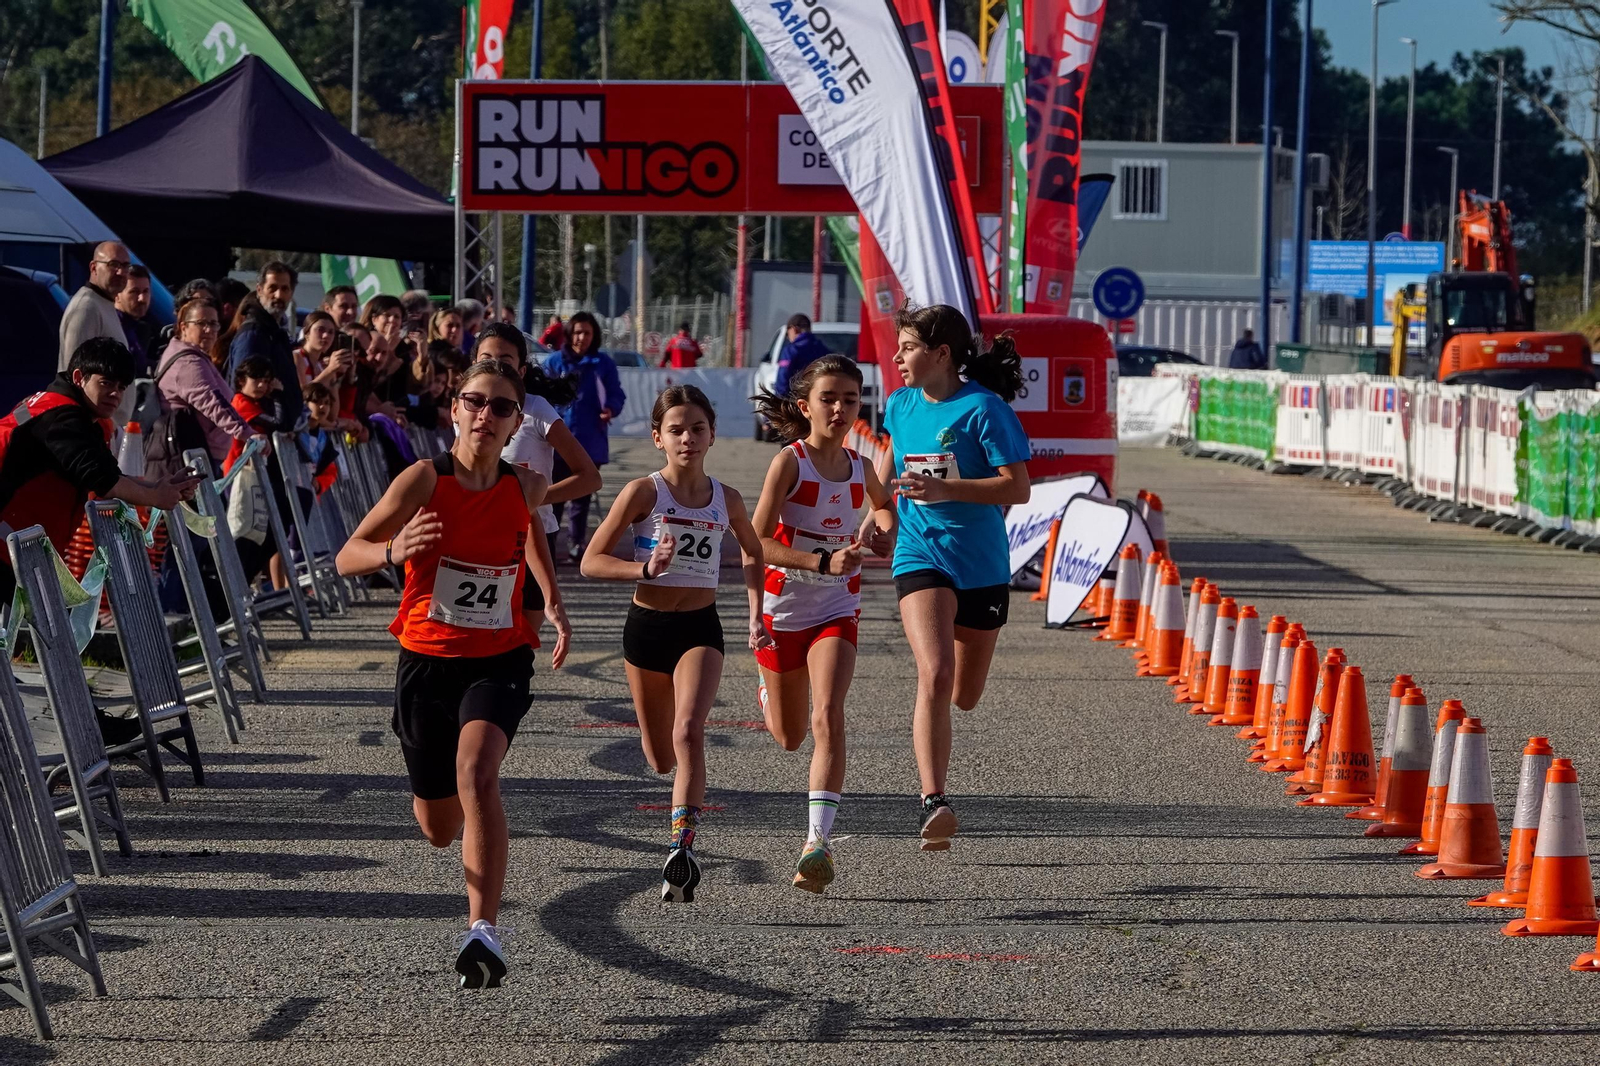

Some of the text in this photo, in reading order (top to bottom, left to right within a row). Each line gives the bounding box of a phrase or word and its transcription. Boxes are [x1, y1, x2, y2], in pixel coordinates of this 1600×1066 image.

[770, 0, 845, 104] Atlántico
[479, 99, 601, 144] RUN
[803, 152, 831, 168] DE
[1496, 352, 1550, 363] mateco
[677, 532, 713, 560] 26
[476, 568, 496, 576] VIGO
[454, 581, 499, 609] 24
